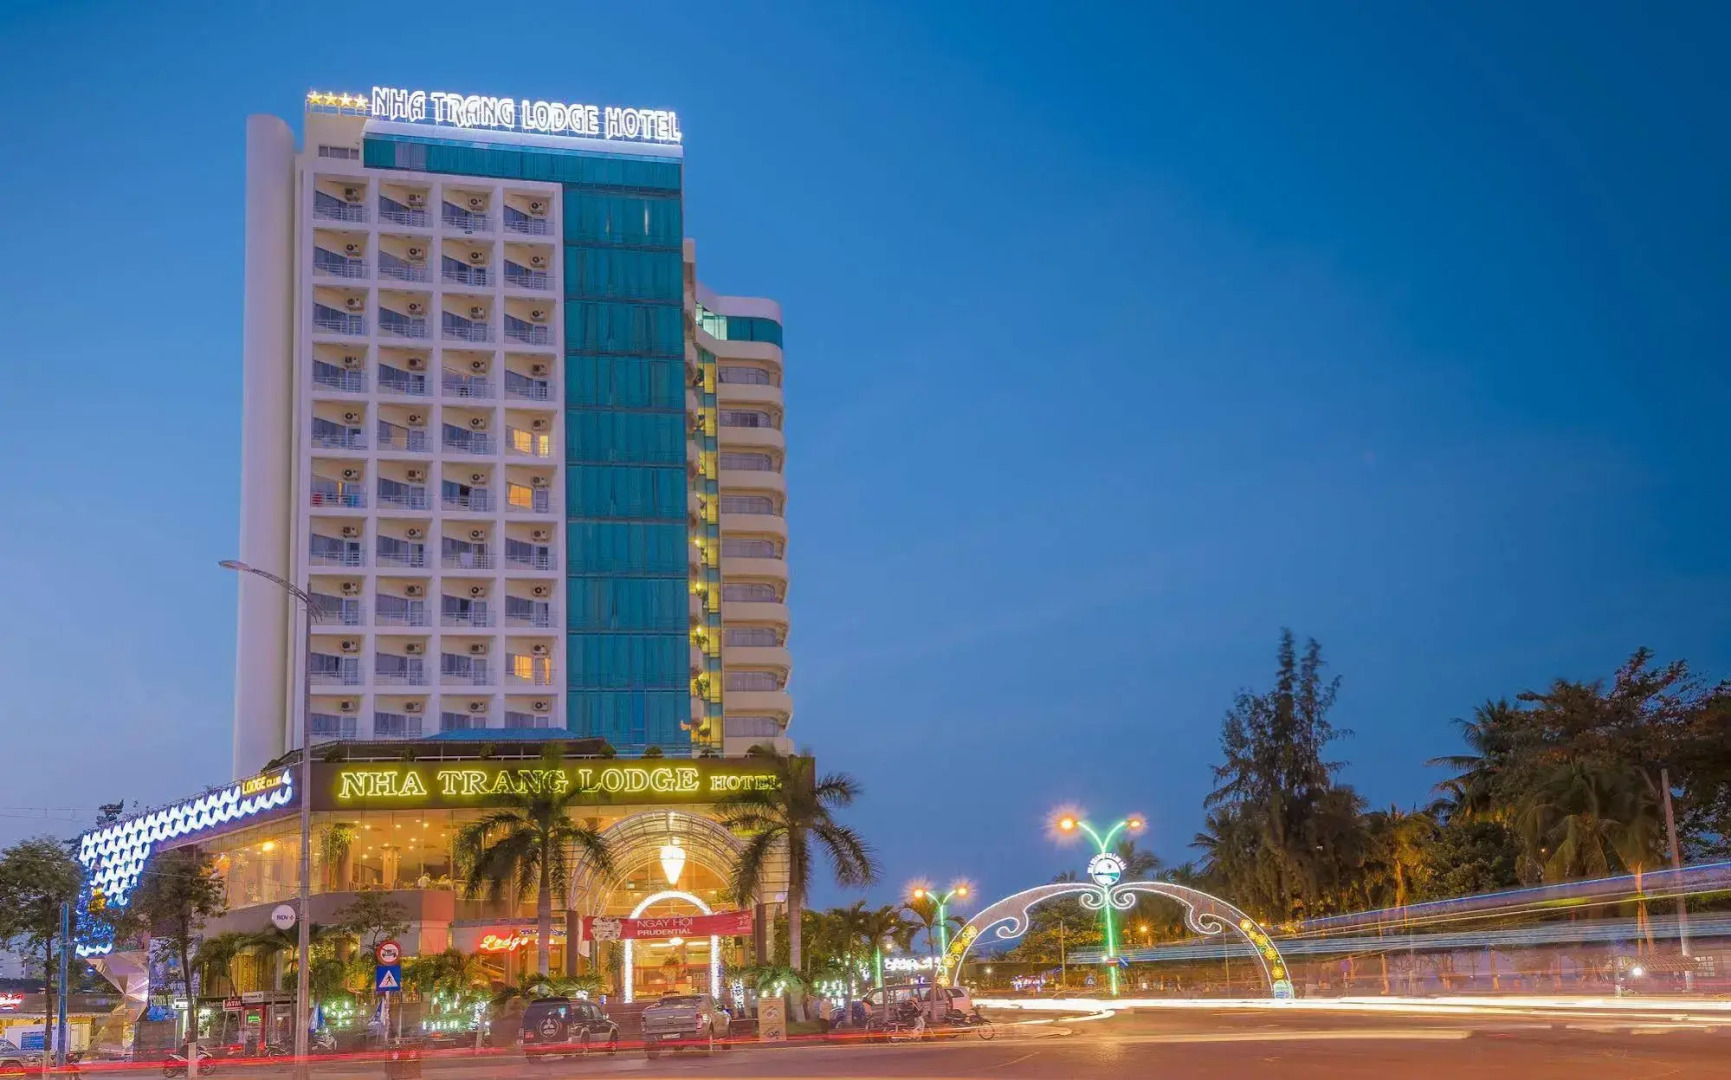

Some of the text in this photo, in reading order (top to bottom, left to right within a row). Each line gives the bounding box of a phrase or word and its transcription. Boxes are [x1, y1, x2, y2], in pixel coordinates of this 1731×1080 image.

[372, 86, 682, 141] NHA TRANG LODGE HOTEL
[339, 768, 783, 798] NHA TRANG LODGE HOTEL
[480, 933, 528, 951] Lodge
[637, 928, 693, 936] PRUDENTIAL
